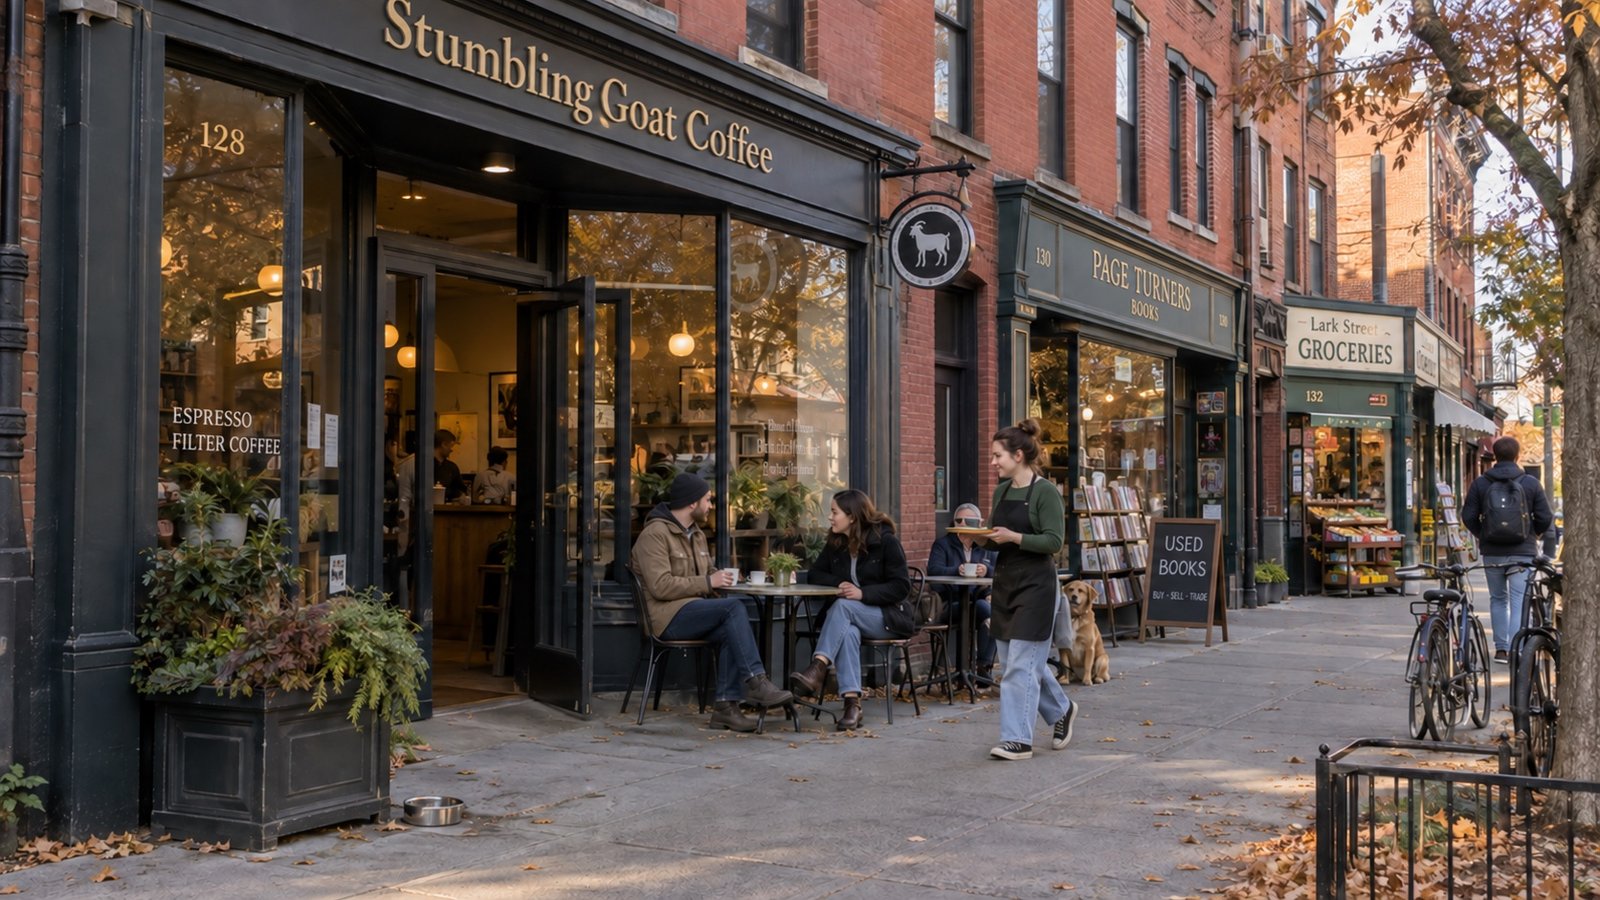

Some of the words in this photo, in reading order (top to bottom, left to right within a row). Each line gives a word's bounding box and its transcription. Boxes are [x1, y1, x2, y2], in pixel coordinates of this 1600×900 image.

[384, 0, 594, 125] Stumbling
[599, 78, 678, 141] Goat
[686, 110, 773, 173] Coffee
[201, 121, 244, 155] 128
[1036, 247, 1051, 267] 130
[1092, 250, 1129, 289] PAGE
[1134, 266, 1191, 311] TURNERS
[1131, 298, 1159, 321] BOOKS
[1311, 316, 1339, 333] Lark
[1343, 319, 1378, 335] Street
[1298, 338, 1392, 364] GROCERIES
[1306, 390, 1324, 403] 132
[172, 406, 252, 428] ESPRESSO
[172, 432, 225, 452] FILTER
[229, 435, 281, 455] COFFEE
[1165, 535, 1203, 552] USED
[1159, 559, 1206, 577] BOOKS
[1152, 590, 1165, 600] BUY
[1170, 591, 1184, 601] SELL
[1189, 592, 1208, 602] TRADE
